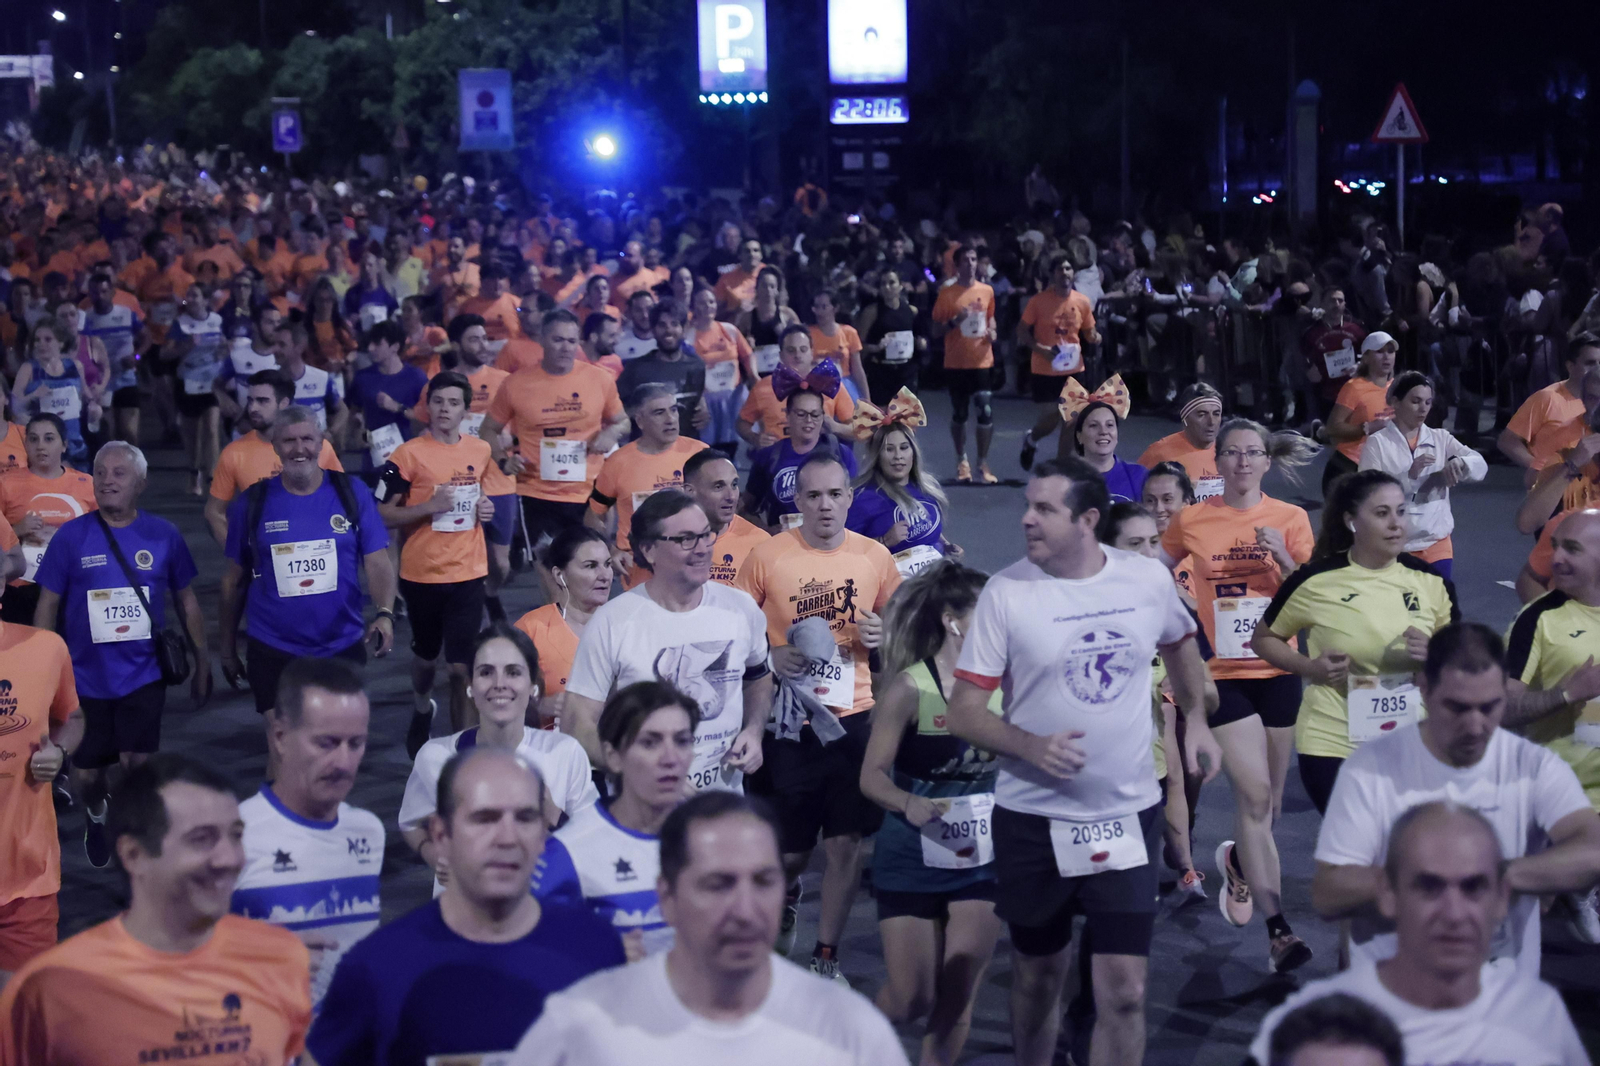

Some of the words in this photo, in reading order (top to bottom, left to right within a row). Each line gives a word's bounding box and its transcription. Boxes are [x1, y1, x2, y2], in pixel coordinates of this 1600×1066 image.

[715, 4, 754, 59] P
[834, 98, 902, 118] 22:06
[551, 454, 579, 464] 14076
[450, 501, 471, 512] 163
[288, 558, 326, 573] 17380
[1212, 553, 1247, 561] SEVILLA
[103, 605, 141, 619] 17385
[797, 592, 835, 614] CARRERA
[810, 662, 841, 681] 8428
[1371, 695, 1407, 713] 7835
[704, 732, 723, 741] mas
[941, 818, 988, 840] 20978
[1071, 821, 1124, 845] 20958
